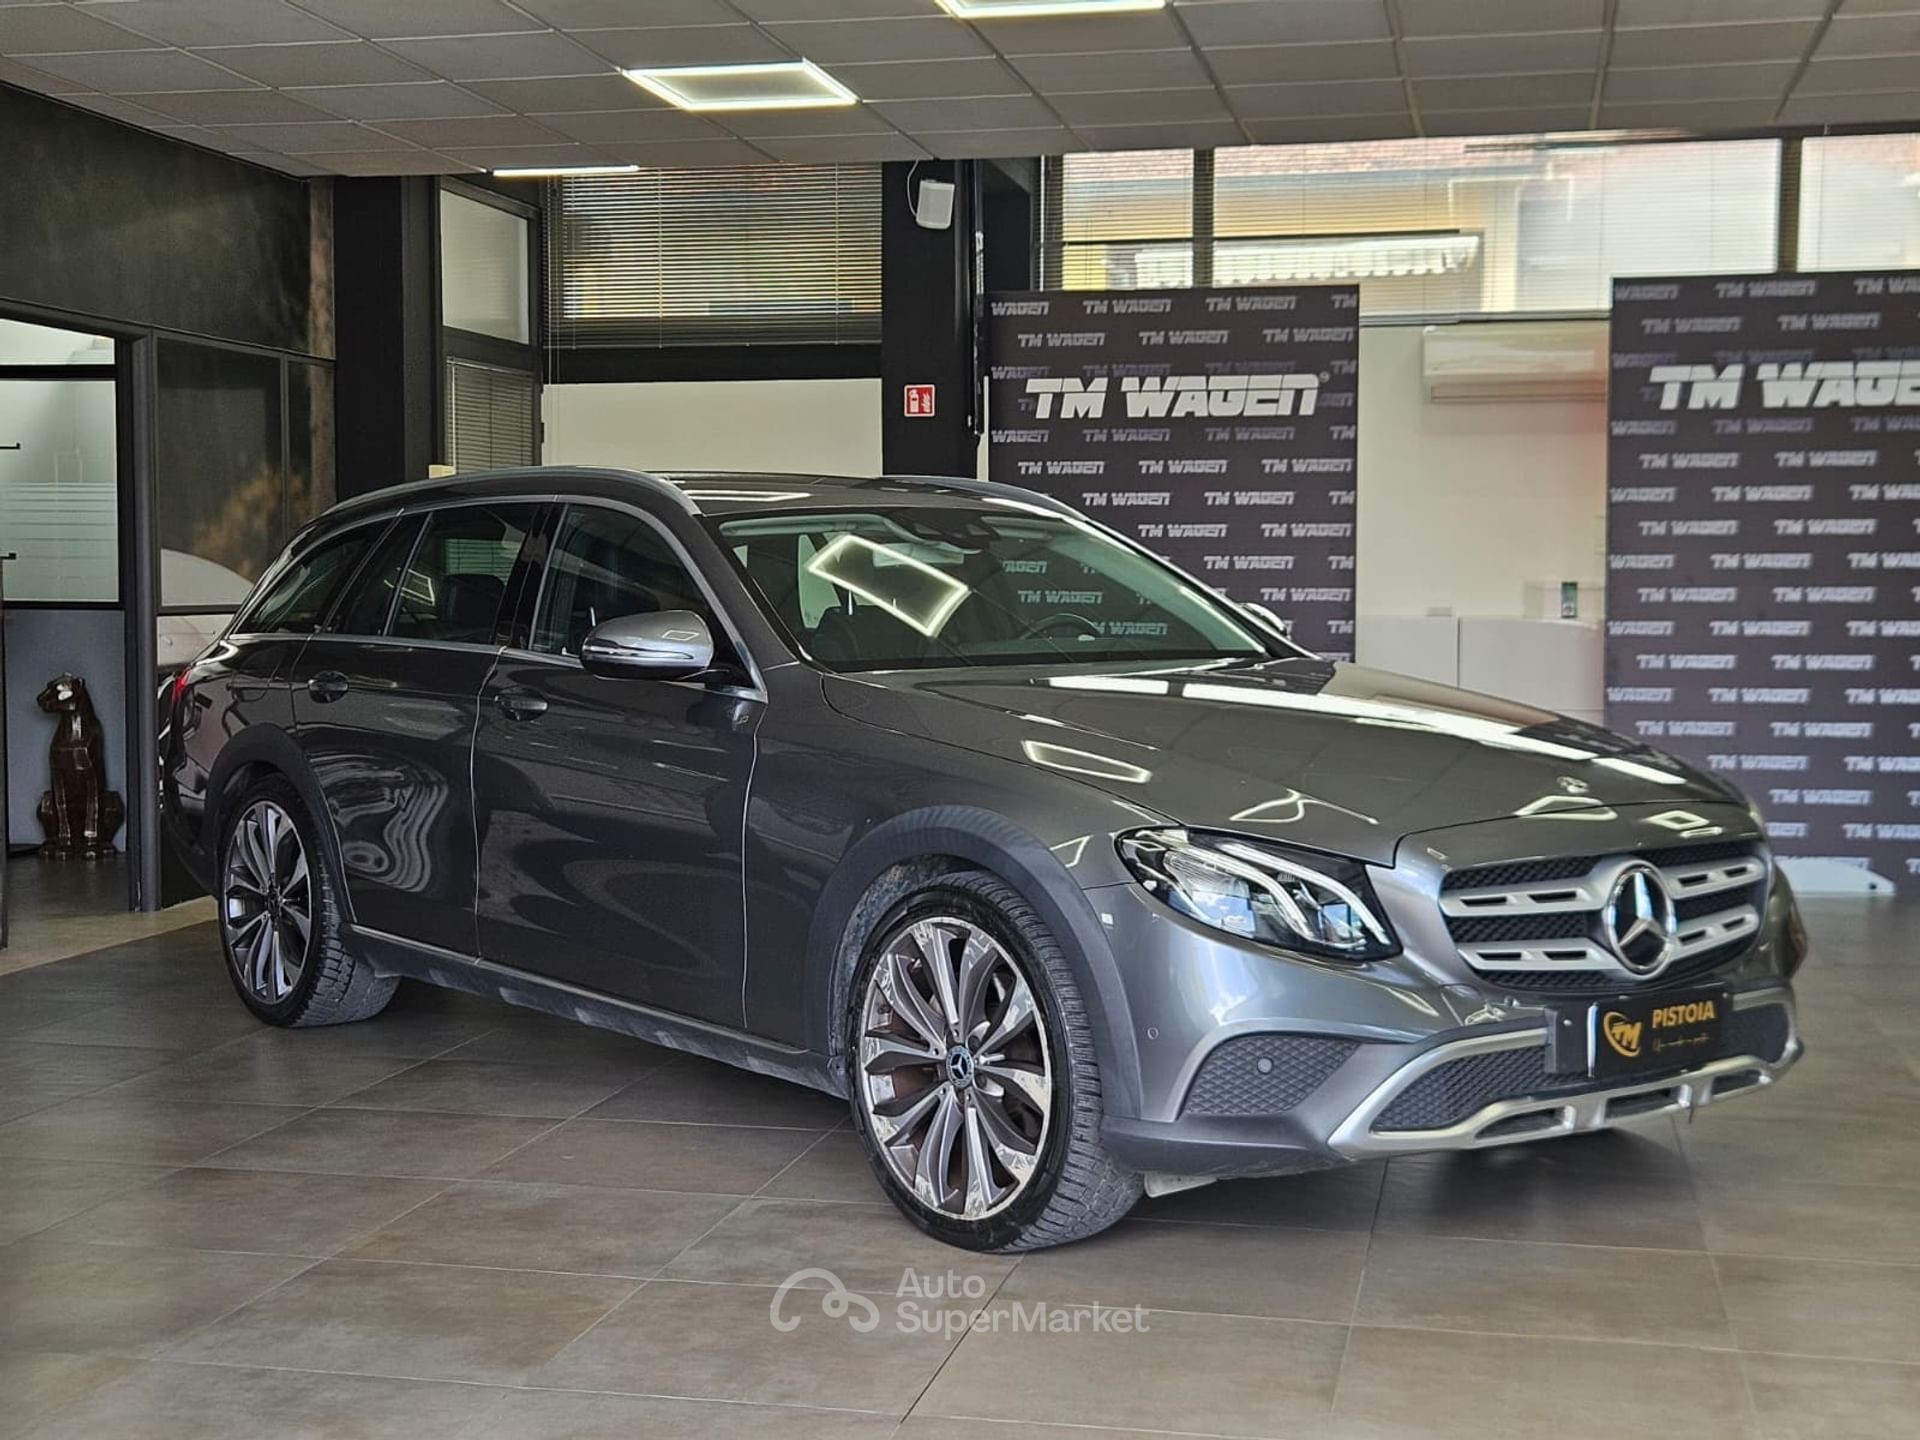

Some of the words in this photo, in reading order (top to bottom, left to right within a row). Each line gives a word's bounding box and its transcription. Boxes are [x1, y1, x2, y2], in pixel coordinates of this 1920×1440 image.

[1083, 301, 1110, 314] TM
[1206, 298, 1233, 312] TM
[1018, 334, 1046, 348] TM
[1139, 332, 1166, 346] TM
[1263, 329, 1291, 342] TM
[1649, 363, 1745, 410] TM
[1026, 377, 1108, 419] TM
[1121, 374, 1319, 417] WAGEN
[1083, 430, 1110, 442] TM
[1205, 428, 1233, 441] TM
[1262, 459, 1289, 473] TM
[1639, 453, 1668, 468] TM
[1775, 451, 1804, 467] TM
[1018, 462, 1045, 475] TM
[1138, 460, 1165, 474] TM
[1205, 492, 1233, 505] TM
[1712, 486, 1741, 501] TM
[1849, 484, 1879, 500] TM
[1083, 493, 1110, 506] TM
[1138, 525, 1165, 538] TM
[1261, 524, 1289, 537] TM
[1638, 521, 1667, 535] TM
[1774, 519, 1803, 535] TM
[1204, 556, 1231, 570] TM
[1710, 554, 1739, 569] TM
[1847, 553, 1878, 569] TM
[1260, 588, 1289, 601] TM
[1637, 588, 1665, 602] TM
[1772, 586, 1802, 602] TM
[1709, 621, 1738, 636] TM
[1846, 621, 1876, 636] TM
[1636, 655, 1664, 669] TM
[1771, 654, 1801, 670] TM
[1708, 688, 1737, 702] TM
[1845, 688, 1875, 704] TM
[1636, 721, 1664, 735] TM
[1769, 722, 1800, 736] TM
[1707, 755, 1736, 769] TM
[1843, 756, 1874, 771] TM
[1768, 789, 1798, 804] TM
[1842, 823, 1873, 838] TM
[1652, 1001, 1715, 1028] PISTOIA
